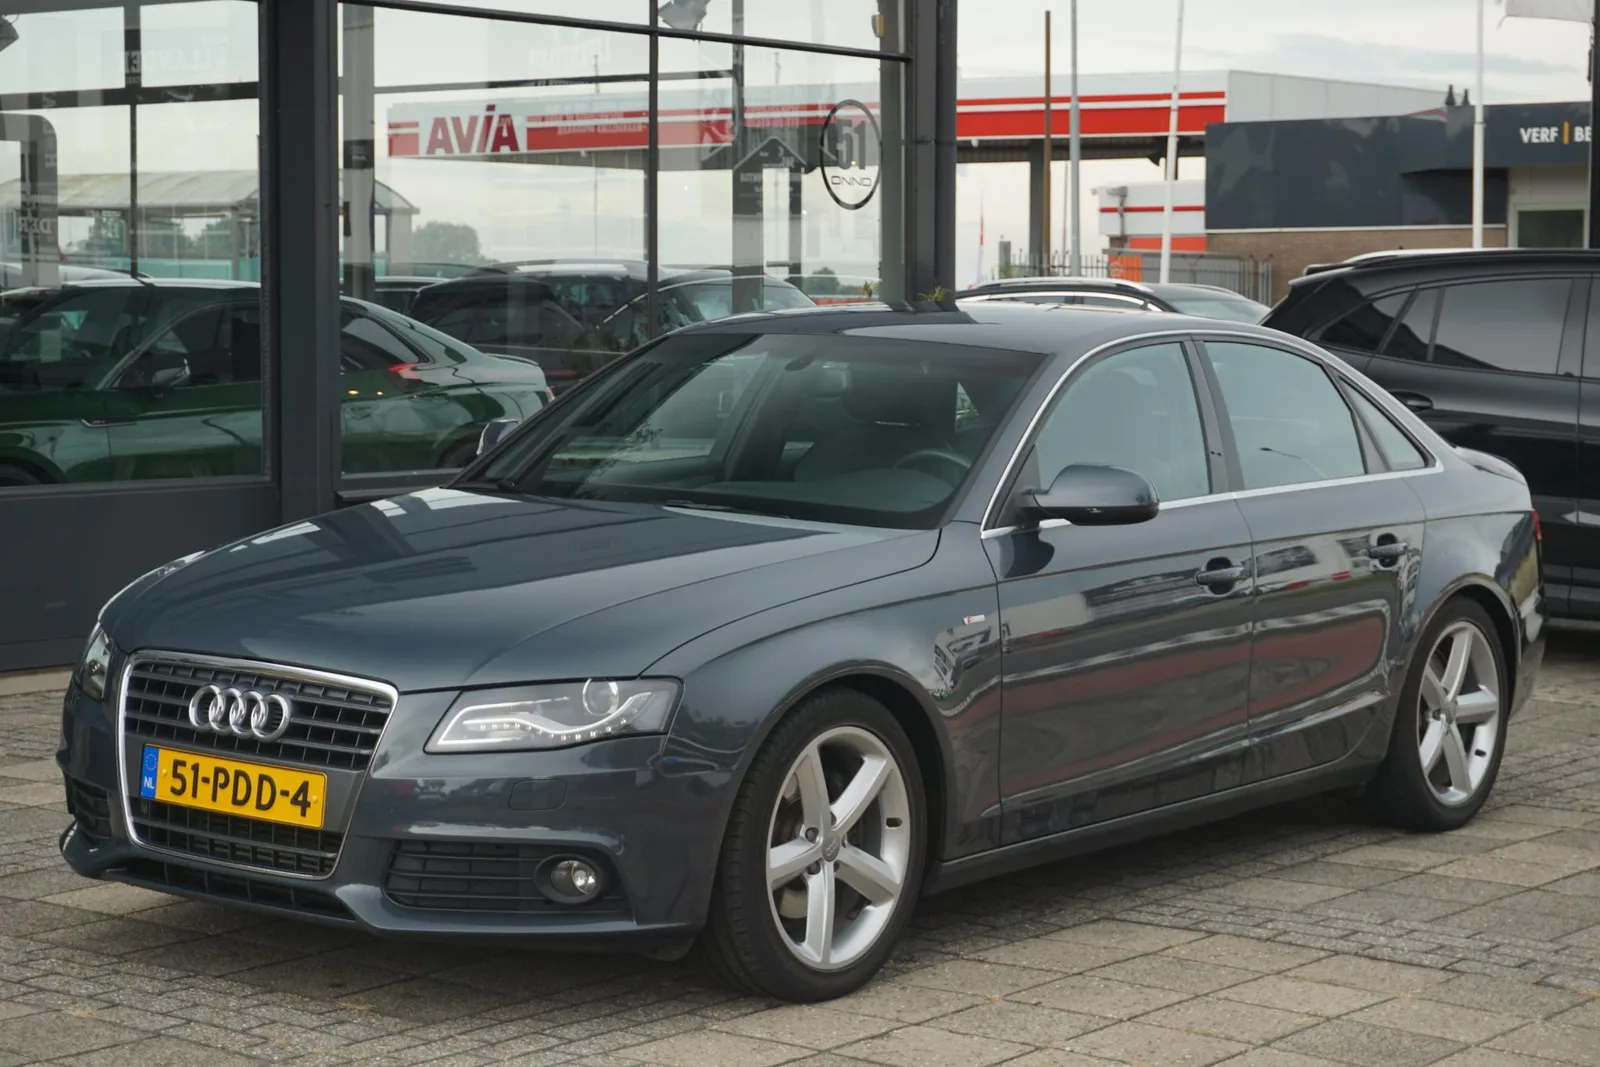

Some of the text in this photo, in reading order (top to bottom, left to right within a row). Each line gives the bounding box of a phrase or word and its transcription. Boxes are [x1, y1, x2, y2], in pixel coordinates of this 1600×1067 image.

[425, 104, 520, 155] AVIA
[835, 119, 867, 170] 51
[1519, 126, 1559, 143] VERF
[143, 776, 155, 789] NL
[170, 759, 311, 817] 51-PDD-4
